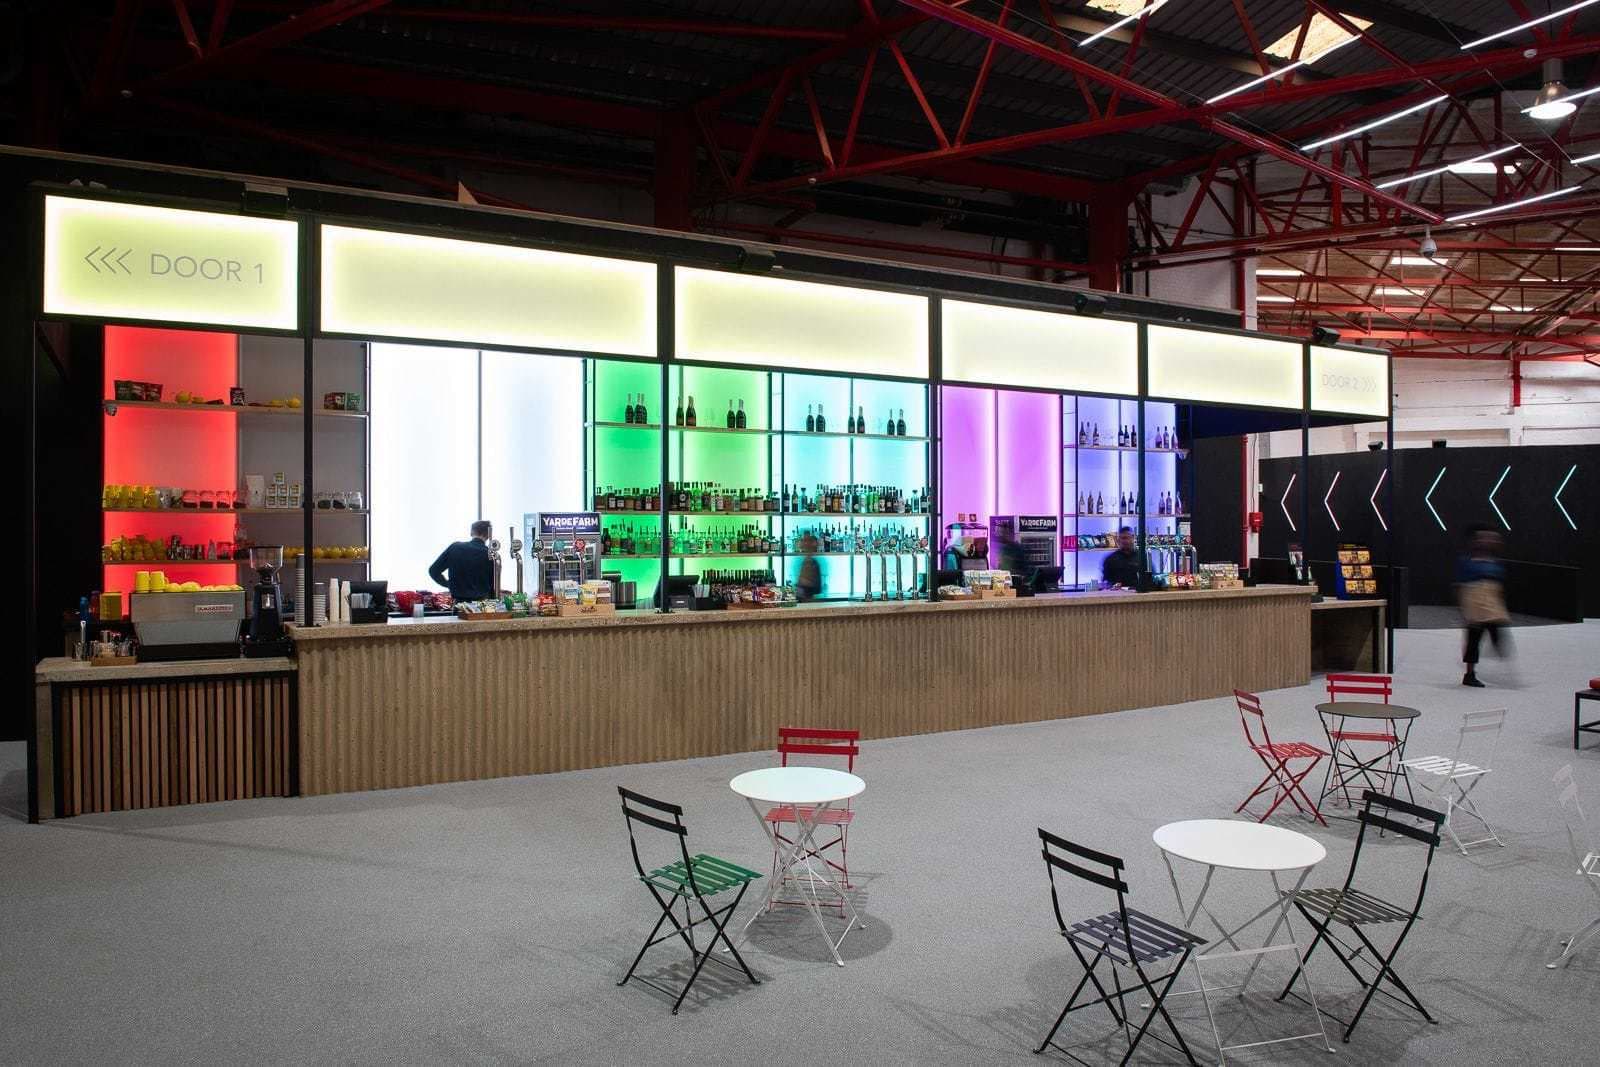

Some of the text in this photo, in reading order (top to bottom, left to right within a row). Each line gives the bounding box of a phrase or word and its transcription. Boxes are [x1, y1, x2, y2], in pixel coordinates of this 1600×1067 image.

[151, 253, 263, 284] DOOR 1
[1322, 374, 1351, 389] DOOR
